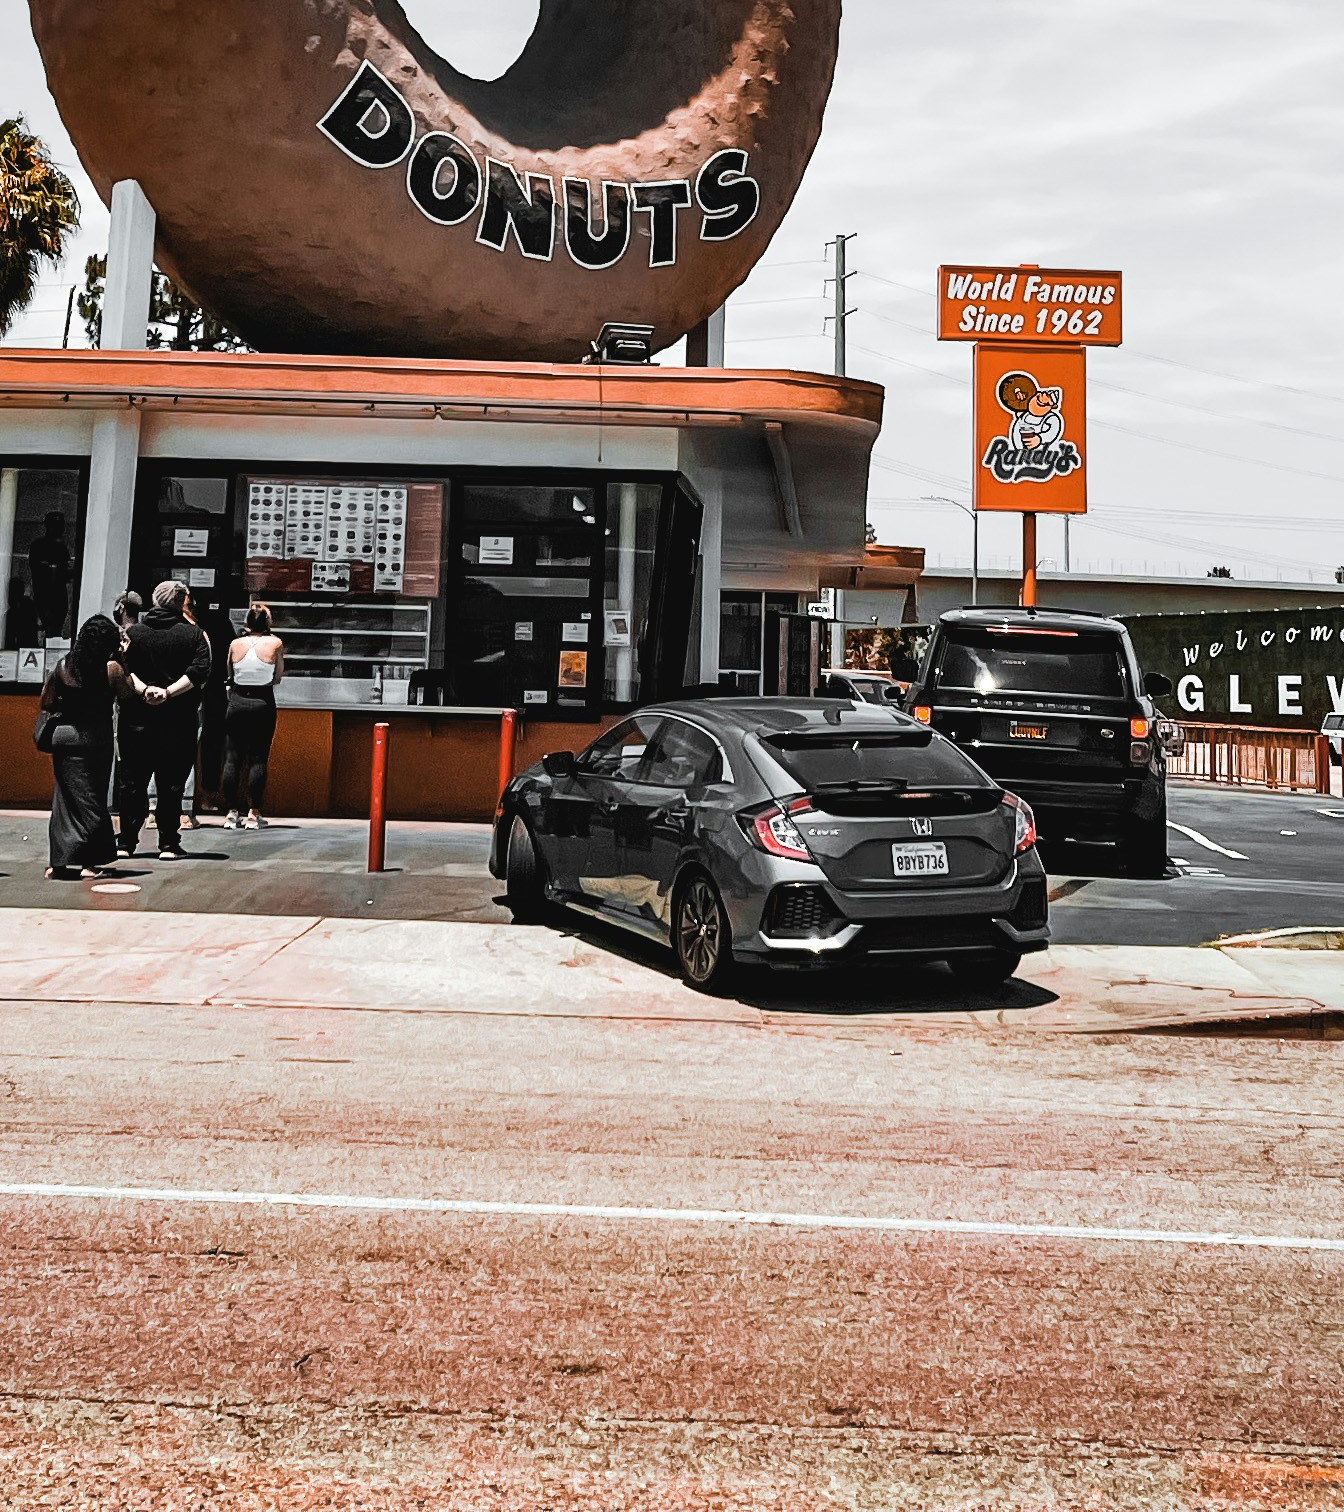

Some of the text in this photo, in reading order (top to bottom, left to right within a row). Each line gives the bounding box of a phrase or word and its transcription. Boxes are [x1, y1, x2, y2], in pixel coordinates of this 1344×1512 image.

[316, 59, 760, 270] DONUTS
[947, 272, 1116, 305] World Famous
[958, 305, 1104, 336] Since 1962
[984, 436, 1080, 481] Randy's
[23, 651, 39, 668] A
